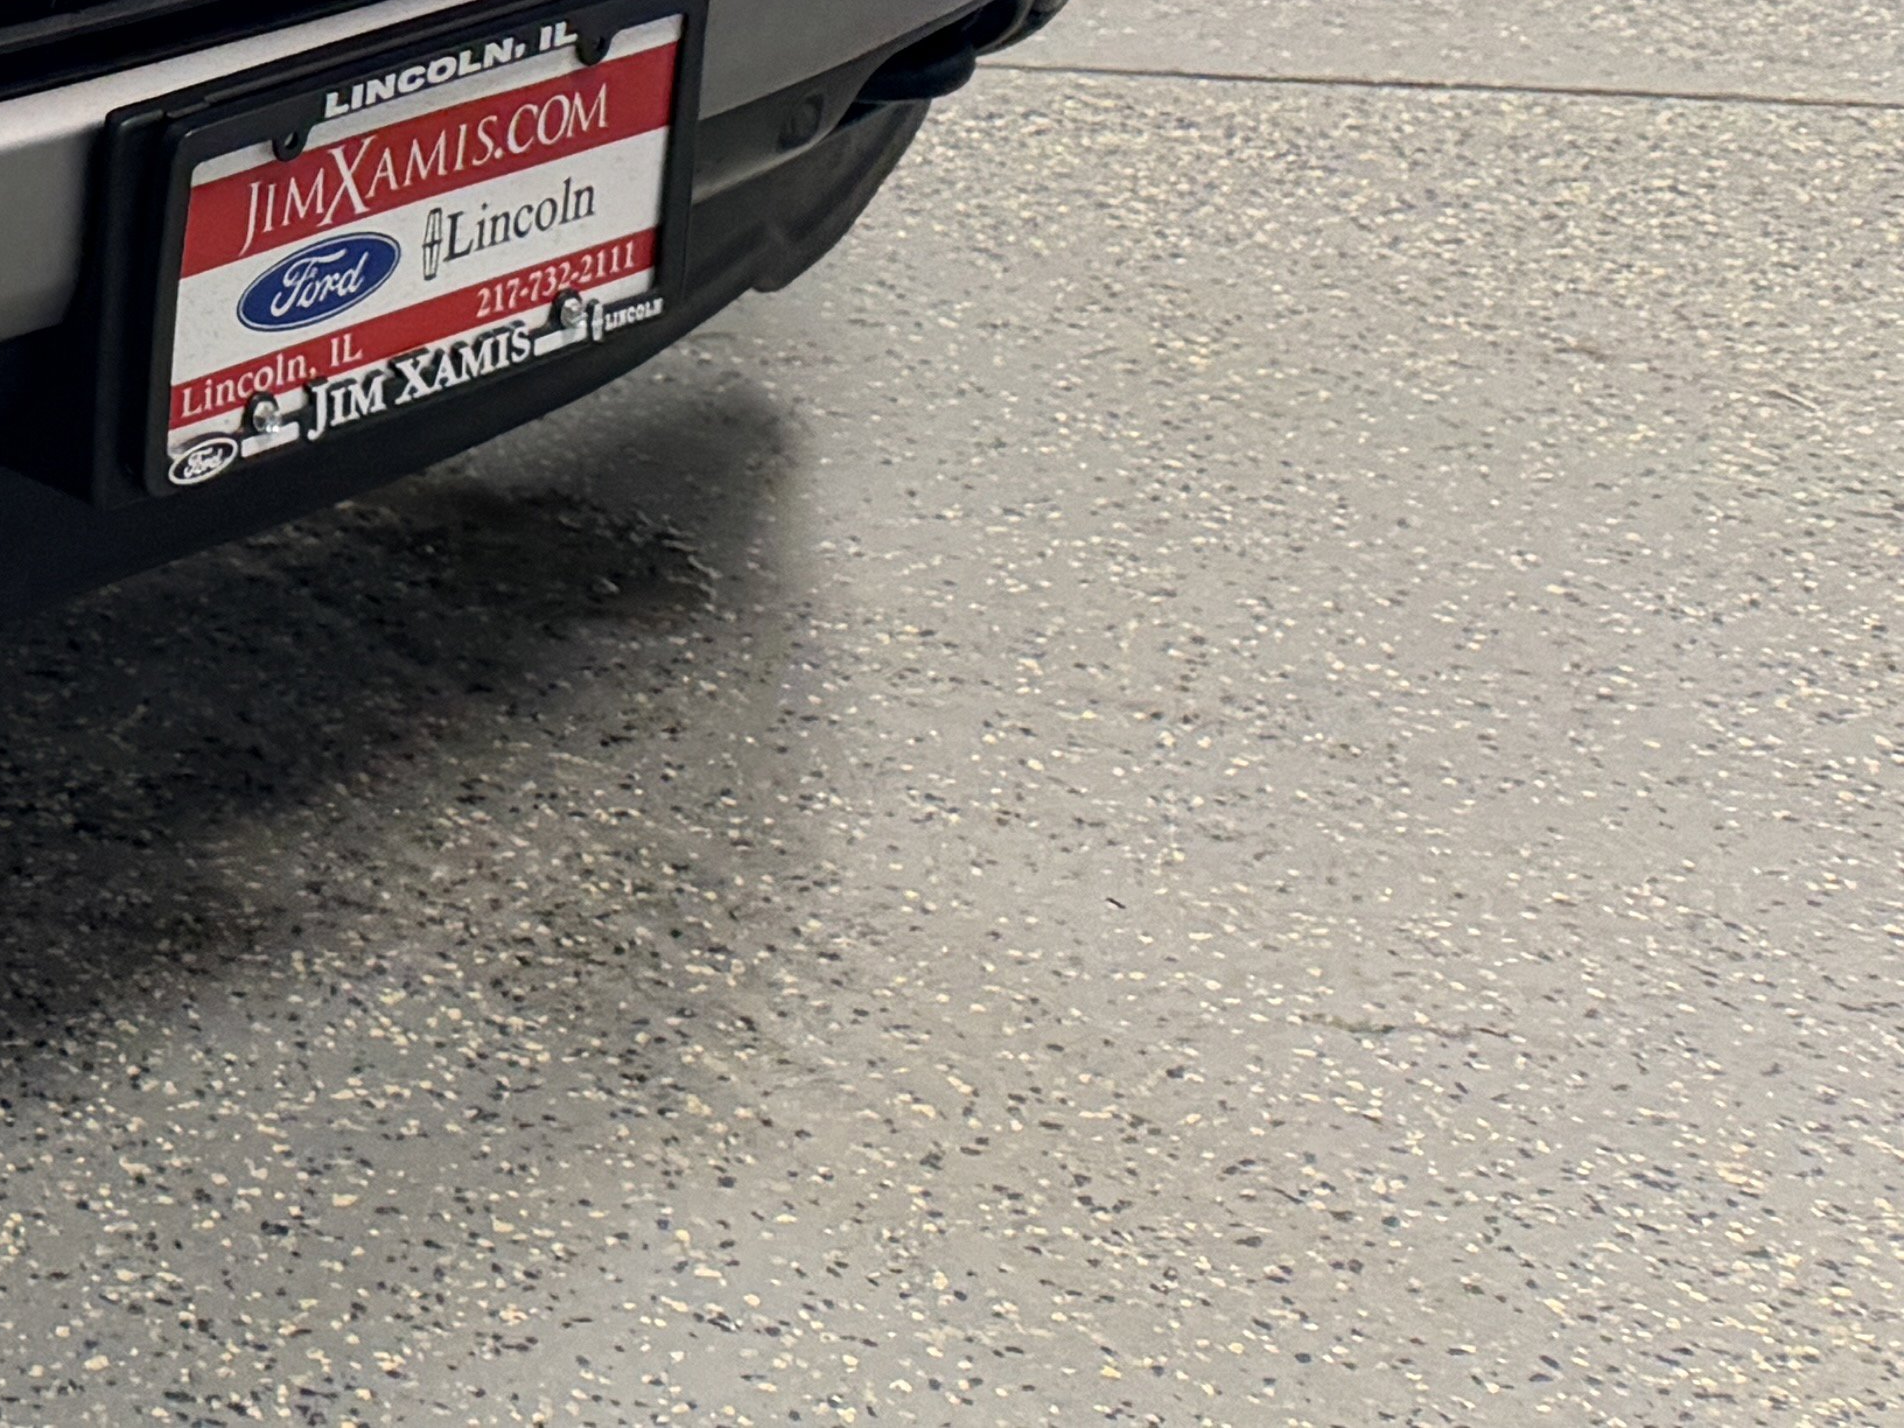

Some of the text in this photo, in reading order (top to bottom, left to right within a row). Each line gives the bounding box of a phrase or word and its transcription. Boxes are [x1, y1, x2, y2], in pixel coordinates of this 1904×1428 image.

[539, 21, 579, 51] IL
[239, 82, 609, 258] JIMXAMIS.COM
[443, 176, 596, 262] Lincoln
[270, 248, 370, 318] Ford
[476, 240, 635, 318] 217-732-2111
[181, 333, 364, 419] Lincoln, IL
[307, 325, 533, 442] JIM XAMIS
